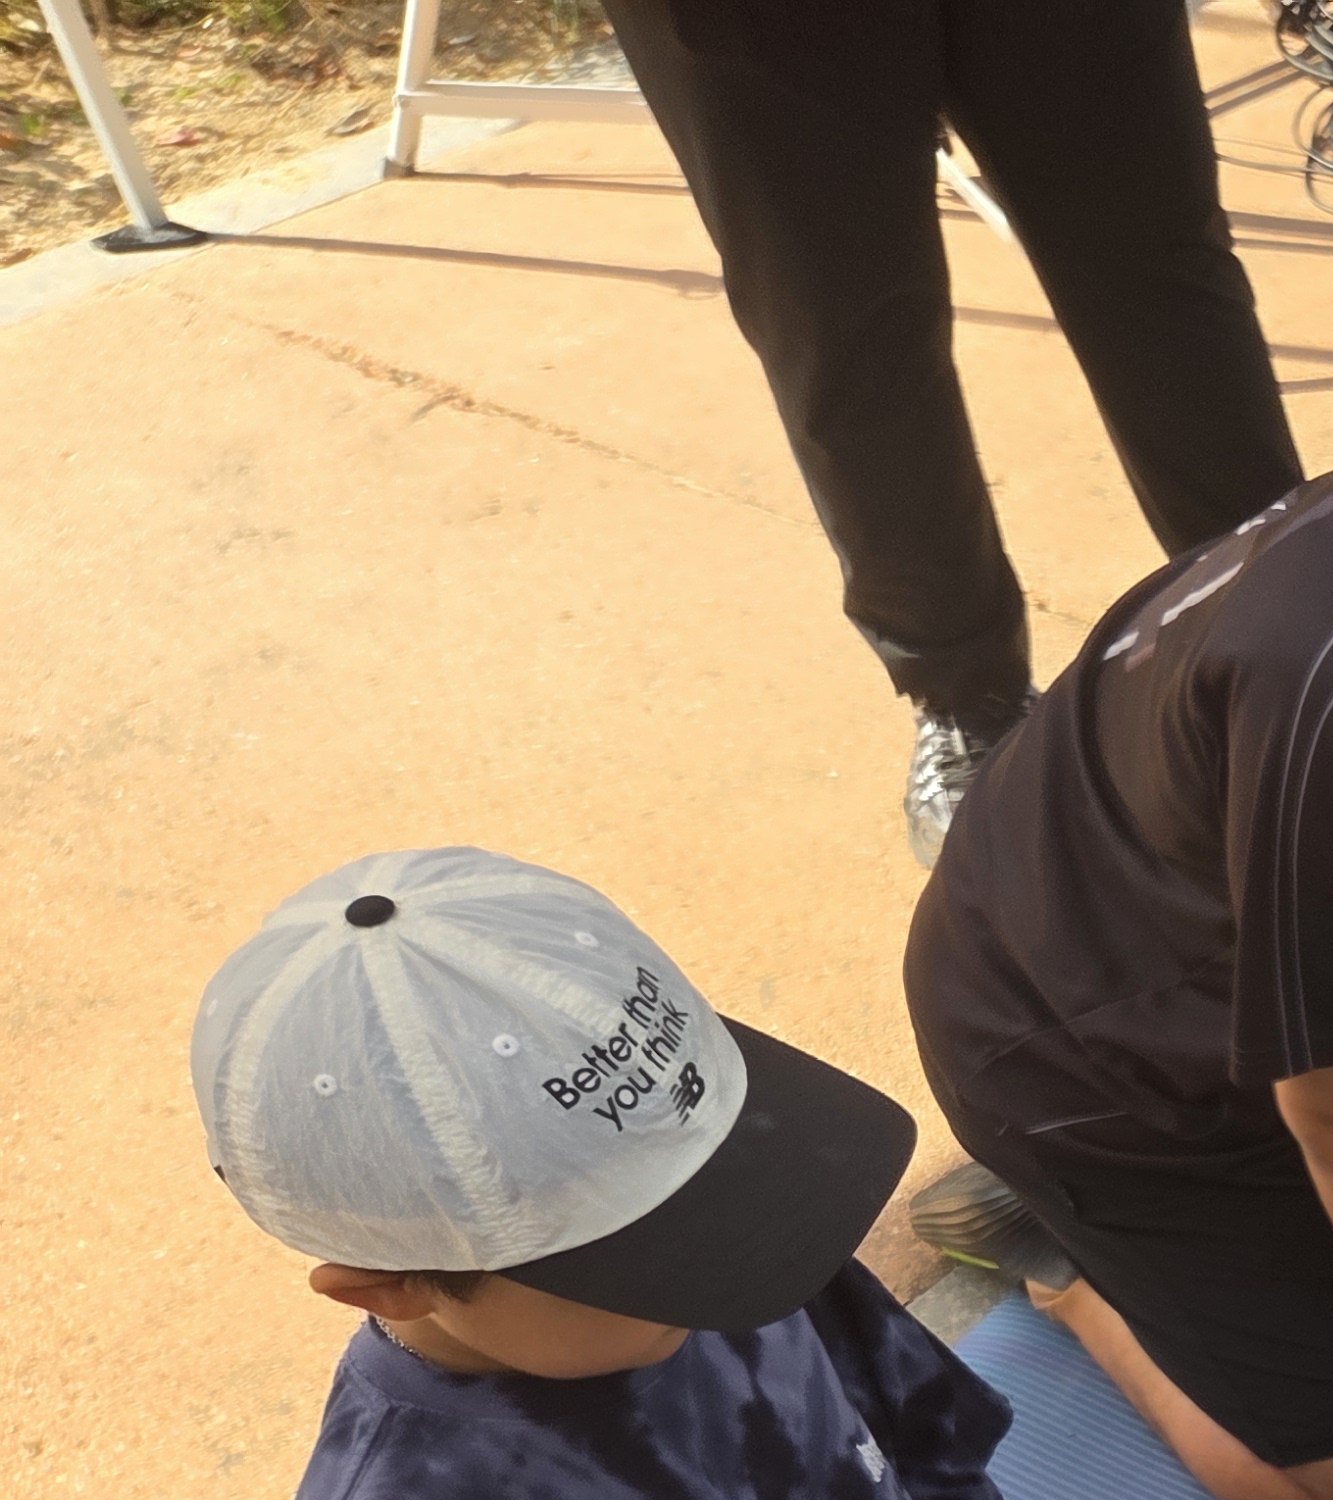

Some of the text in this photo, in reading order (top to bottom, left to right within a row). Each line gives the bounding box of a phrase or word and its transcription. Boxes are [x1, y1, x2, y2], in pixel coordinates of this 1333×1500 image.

[541, 965, 660, 1110] Better than
[593, 998, 689, 1132] you think
